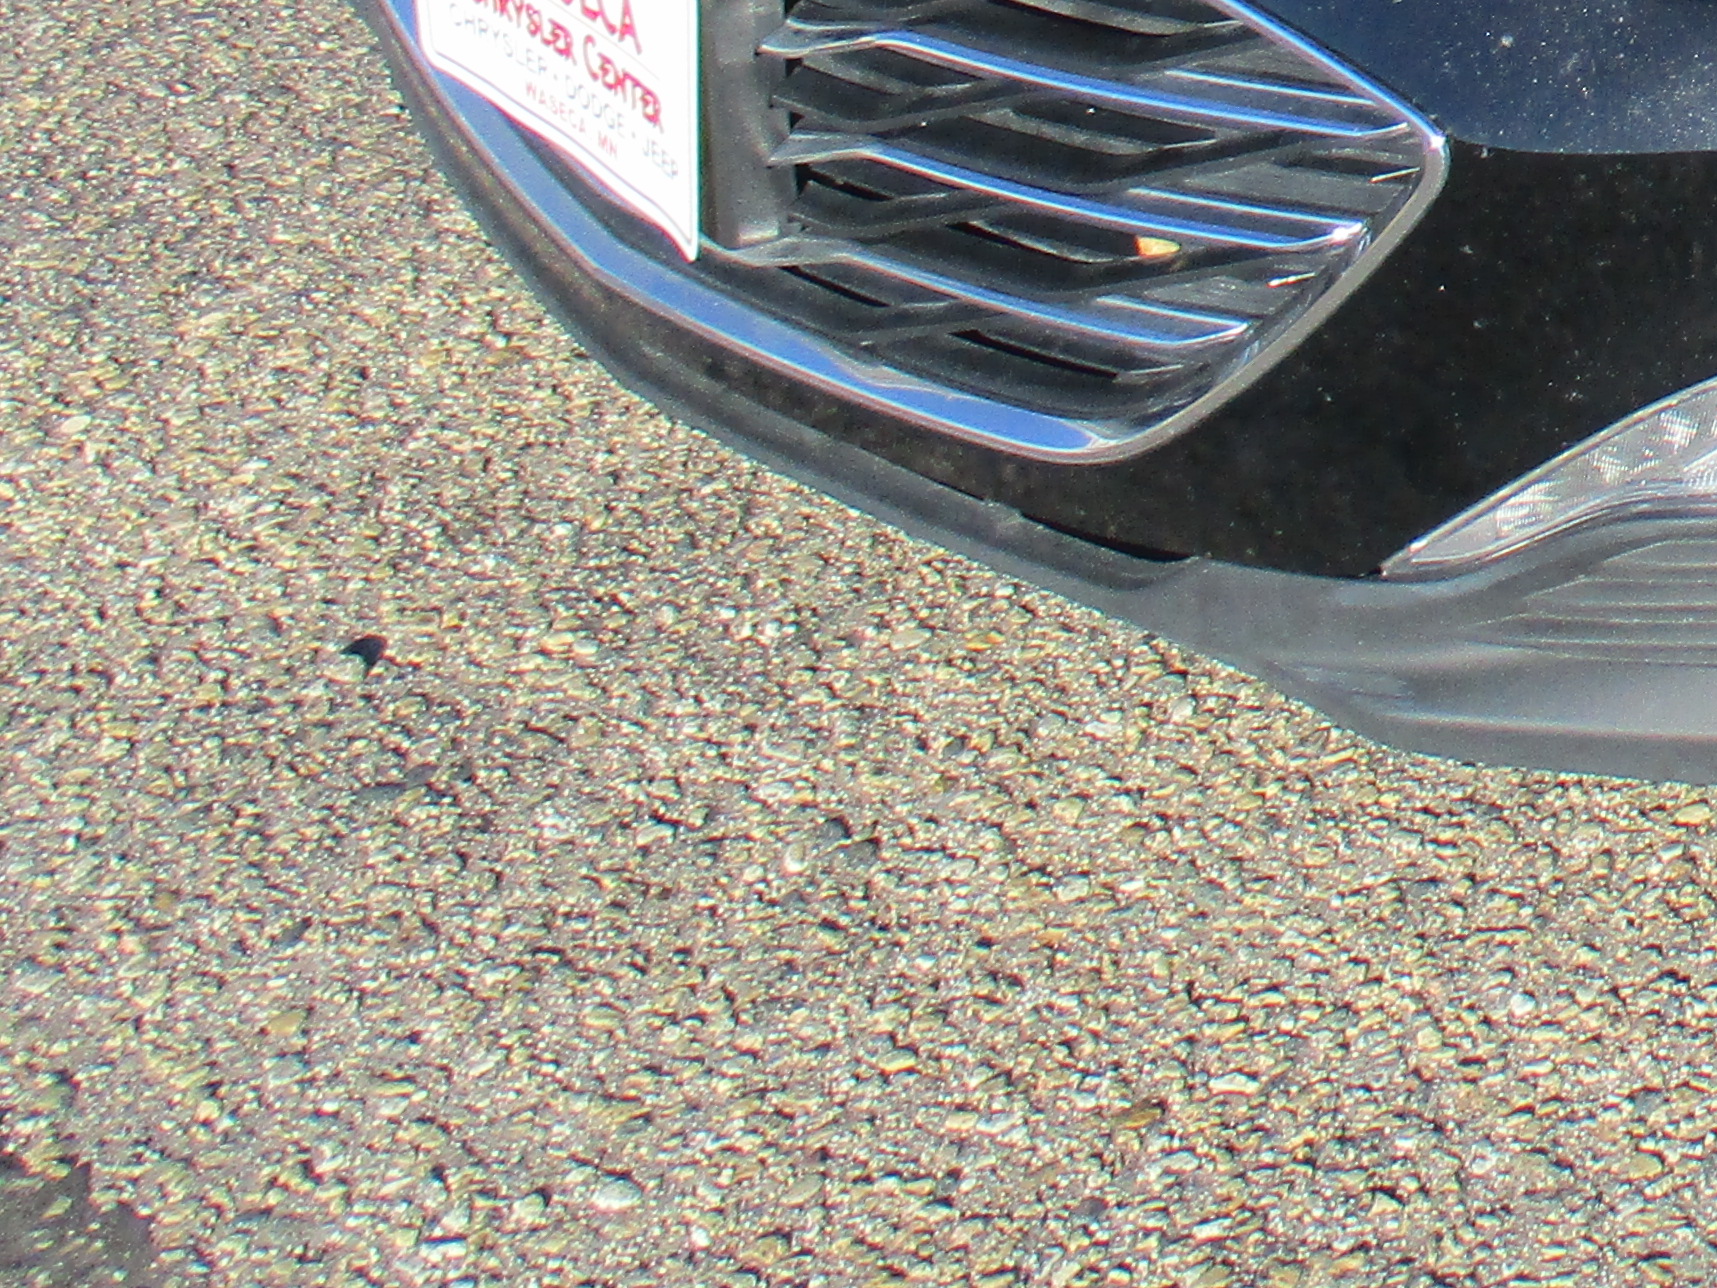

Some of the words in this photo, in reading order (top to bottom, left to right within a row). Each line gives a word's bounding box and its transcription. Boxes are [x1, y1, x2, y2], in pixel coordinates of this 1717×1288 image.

[449, 2, 547, 76] CHRYSLER
[565, 74, 625, 139] DODGE
[642, 137, 679, 181] JEEP
[582, 34, 664, 135] CENTER
[597, 130, 618, 159] MN
